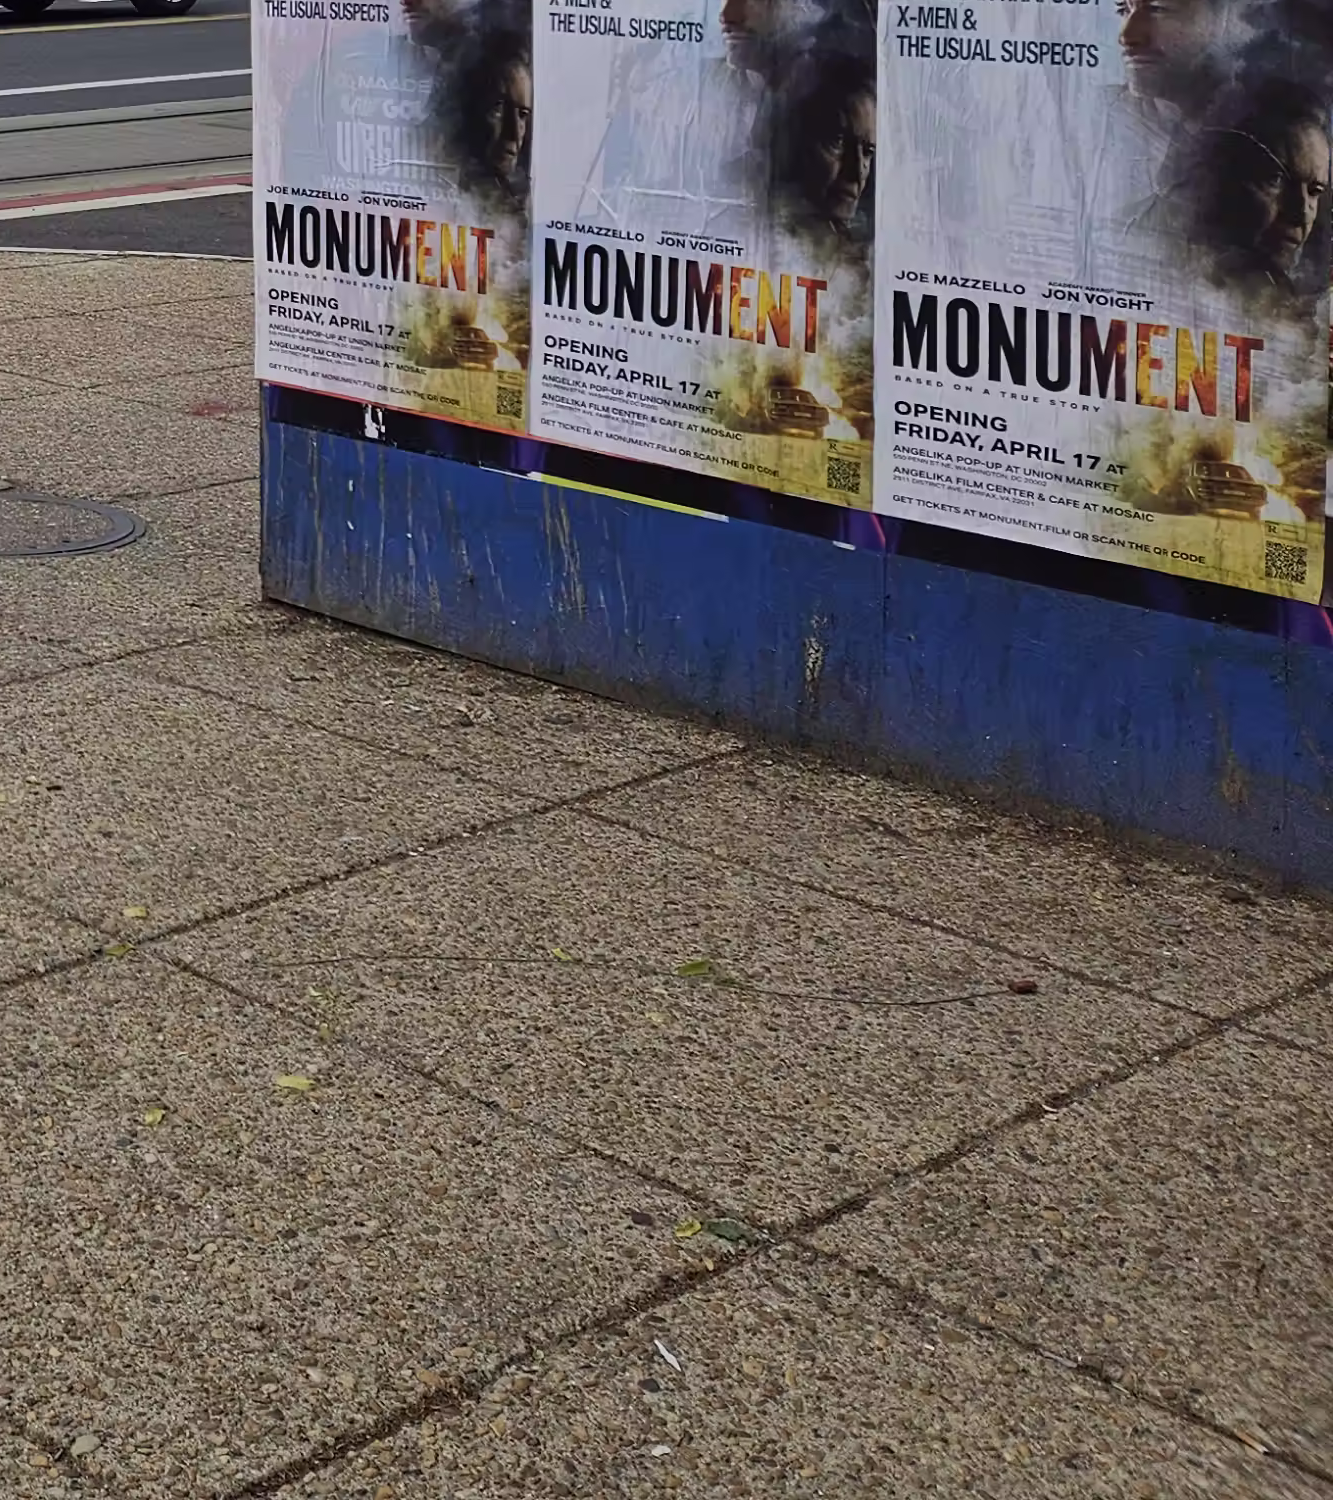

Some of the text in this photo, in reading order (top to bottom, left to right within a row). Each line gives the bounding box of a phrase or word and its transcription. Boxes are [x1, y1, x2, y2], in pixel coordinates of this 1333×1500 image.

[897, 6, 977, 31] X-MEN &
[897, 35, 1099, 67] THE USUAL SUSPECTS
[266, 201, 495, 295] MONUMENT
[544, 237, 828, 354] MONUMENT
[895, 270, 1025, 295] JOE MAZZELLO
[1042, 288, 1154, 311] JON VOIGHT
[543, 352, 722, 401] FRIDAY, APRIL 17 AT
[893, 290, 1264, 423] MONUMENT
[894, 401, 1007, 432] OPENING
[895, 375, 943, 387] BASED
[954, 384, 973, 392] ON
[1000, 391, 1039, 403] TRUE
[1050, 400, 1100, 412] STORY
[893, 445, 1120, 493] ANGELIKA POP-UP AT UNION MARKET
[895, 421, 1128, 475] FRIDAY, APRIL 17 AT
[893, 466, 953, 484] ANGELIKA
[956, 478, 983, 489] FILM
[987, 484, 1034, 499] CENTER
[1037, 492, 1045, 501] &
[1083, 503, 1099, 512] AT
[1102, 505, 1154, 522] MOSAIC
[893, 495, 1206, 564] GET TICKETS AT MONUMENT.FILM OR SCAN THE QR CODE
